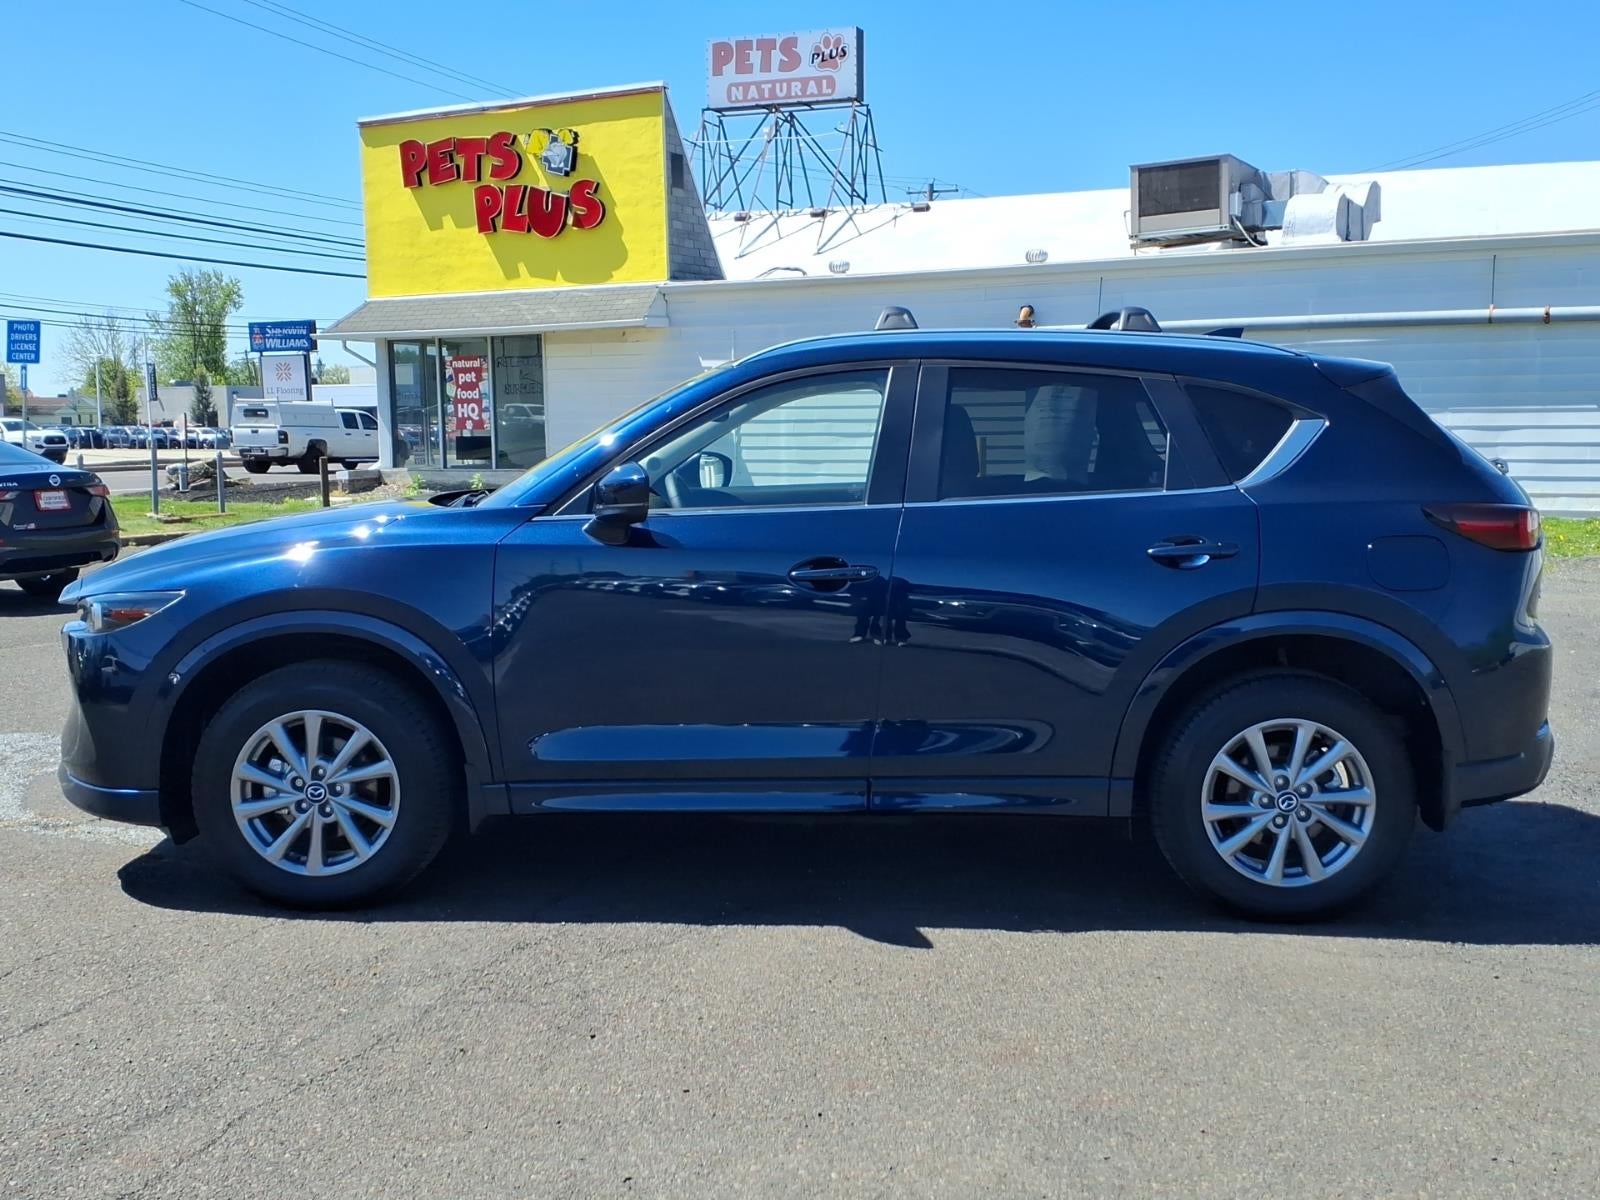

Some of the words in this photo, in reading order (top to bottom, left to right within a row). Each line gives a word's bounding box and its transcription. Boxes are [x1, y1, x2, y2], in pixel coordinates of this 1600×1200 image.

[712, 36, 802, 76] PETS
[811, 45, 848, 64] PLUS
[731, 79, 832, 100] NATURAL
[399, 131, 522, 188] PETS
[473, 178, 606, 239] PLUS
[13, 323, 35, 331] PHOTO
[265, 325, 307, 337] SHERWIN
[10, 333, 37, 341] DRIVERS
[10, 343, 37, 351] LICENSE
[265, 338, 309, 349] WILLIAMS
[11, 352, 35, 360] CENTER
[452, 357, 481, 368] natural
[458, 372, 477, 385] pet
[276, 387, 304, 396] Flooring
[456, 388, 480, 399] food
[457, 403, 479, 420] HQ
